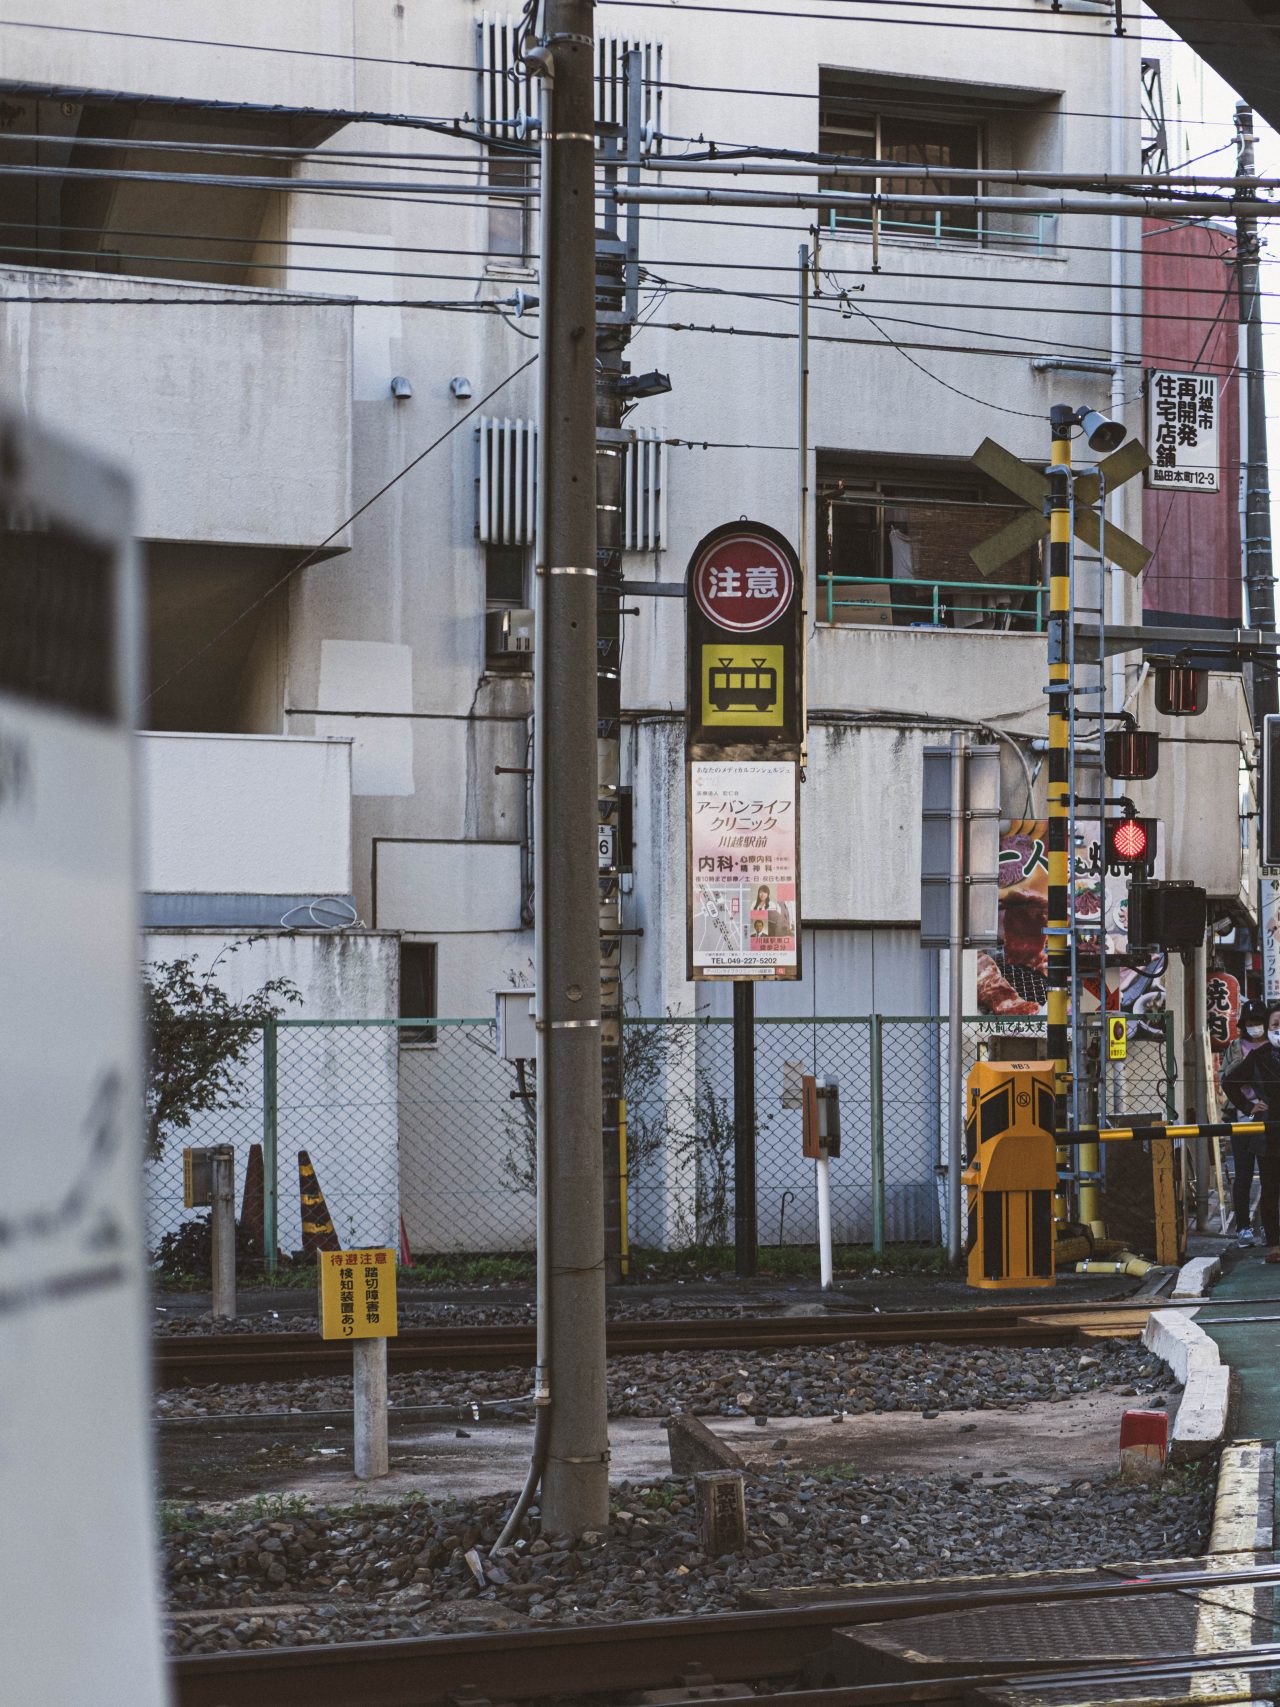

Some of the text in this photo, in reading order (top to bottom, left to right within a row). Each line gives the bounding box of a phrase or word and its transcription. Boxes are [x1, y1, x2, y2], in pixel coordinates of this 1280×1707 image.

[1155, 374, 1177, 468] 住宅店舗
[1177, 377, 1197, 447] 再開発
[1198, 379, 1214, 430] 川越市
[1153, 469, 1215, 485] 脇田本町12-3
[709, 566, 779, 599] 注意
[696, 800, 792, 814] アーバンライフ
[710, 817, 778, 832] クリニック
[718, 836, 768, 848] 川越駅前
[711, 957, 778, 965] TEL.049-227-5202
[1266, 929, 1276, 977] クリニック
[330, 1252, 387, 1267] 待避注意
[339, 1268, 355, 1336] 検知装置あり
[364, 1267, 380, 1324] 踏切障害物
